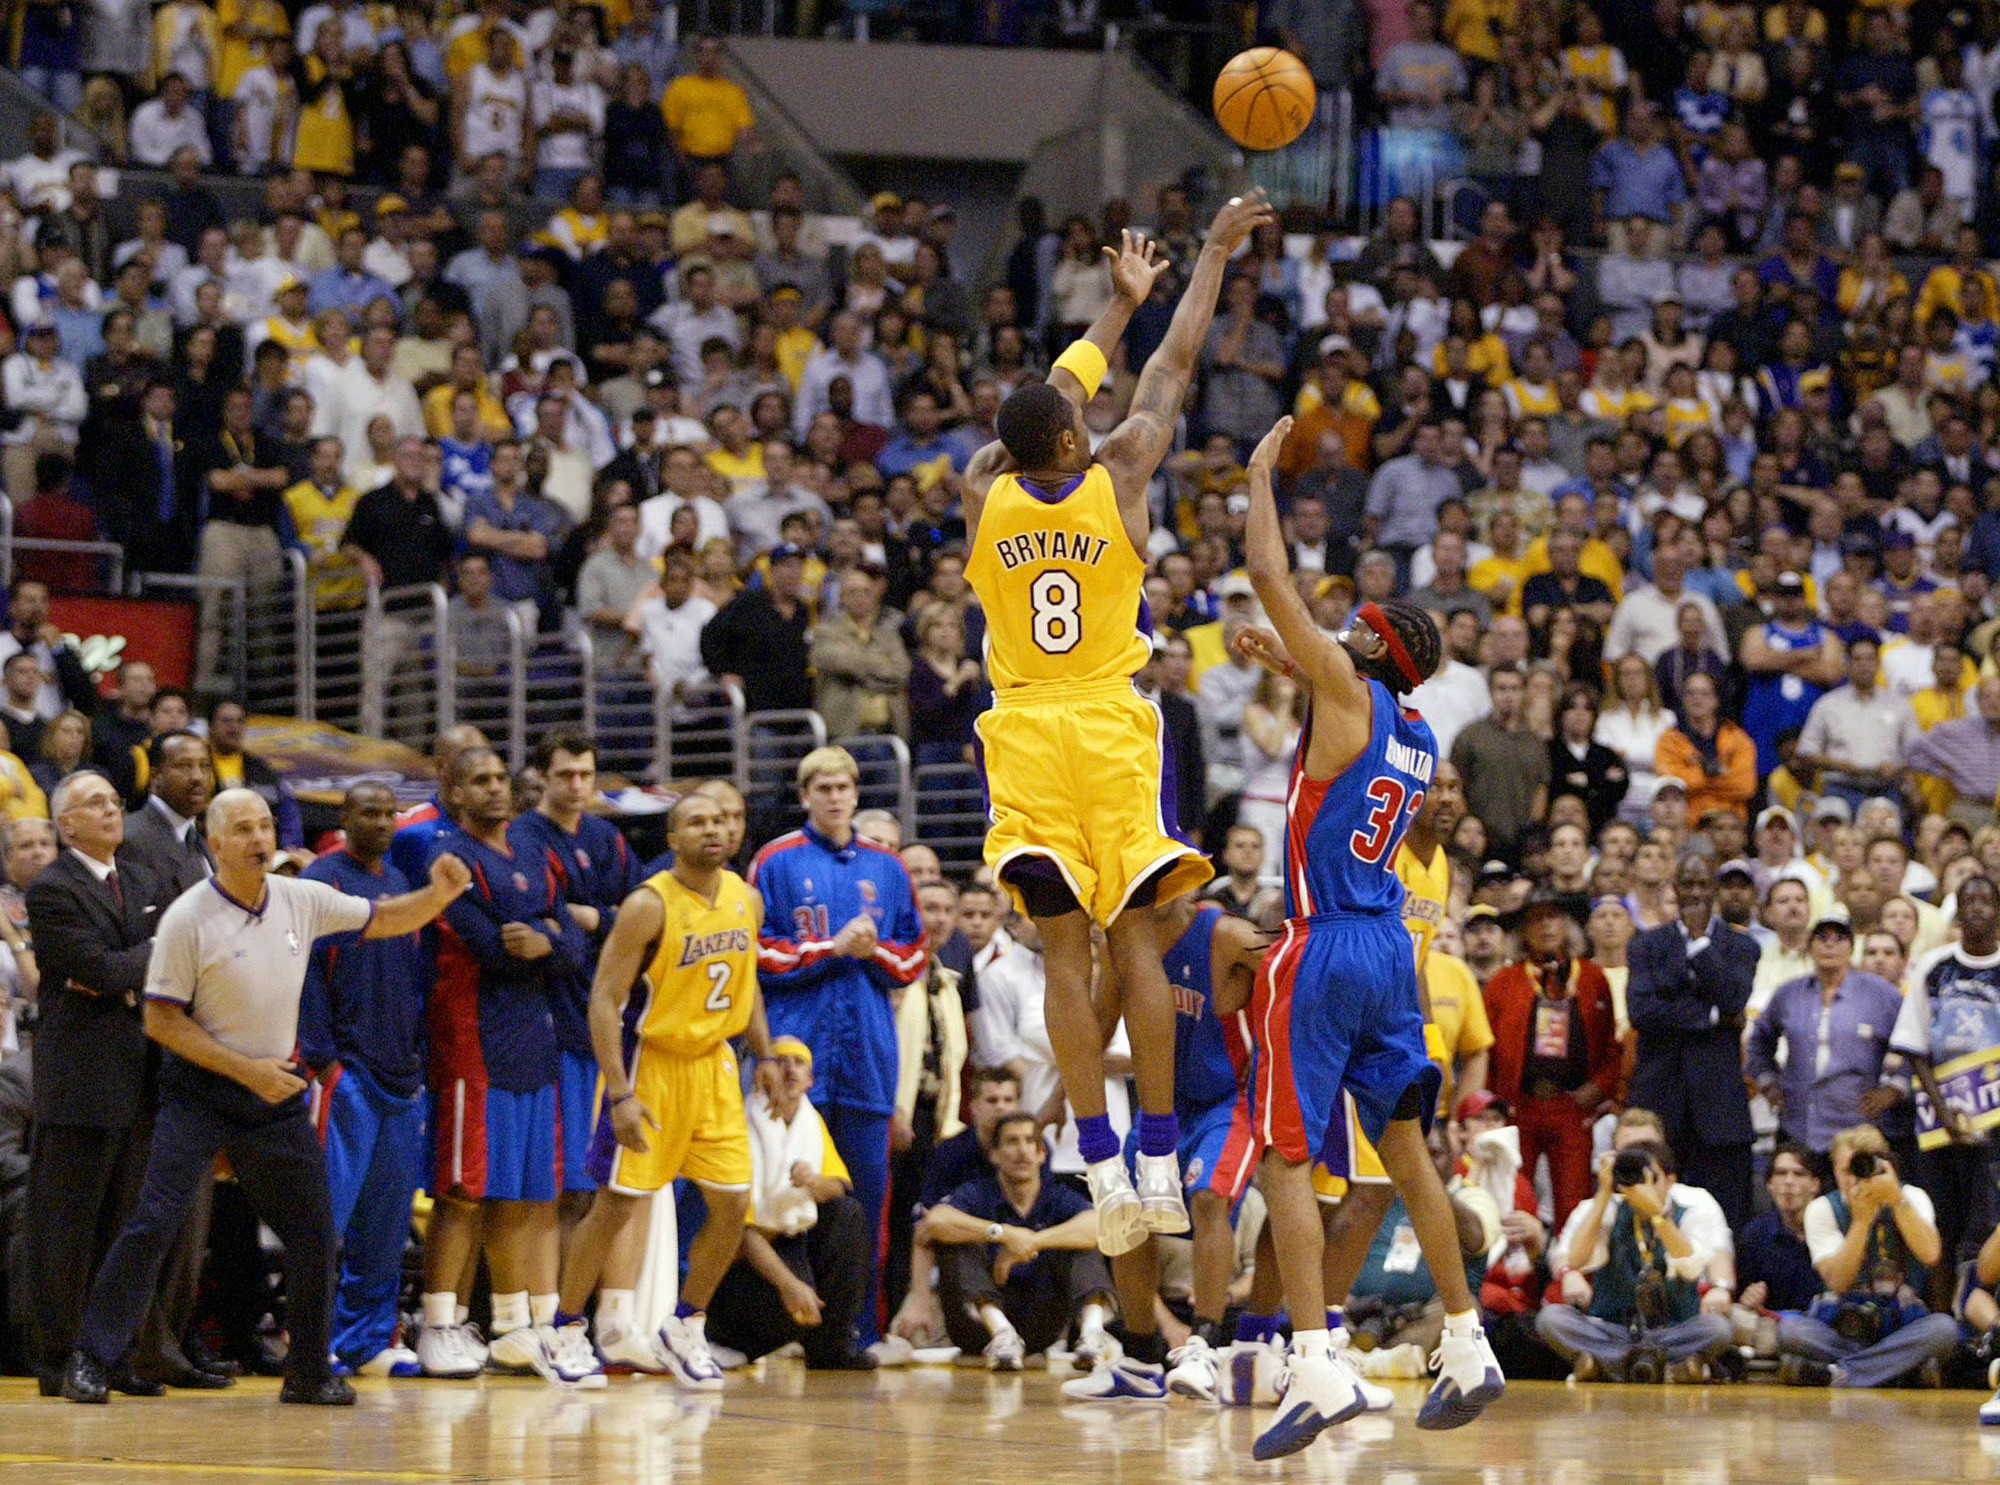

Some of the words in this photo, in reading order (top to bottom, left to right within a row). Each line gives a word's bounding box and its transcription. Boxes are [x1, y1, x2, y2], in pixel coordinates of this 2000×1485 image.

[994, 529, 1111, 571] BRYANT
[1030, 569, 1081, 655] 8
[792, 904, 830, 941] 31
[675, 928, 750, 969] LAKERS
[704, 960, 732, 1013] 2
